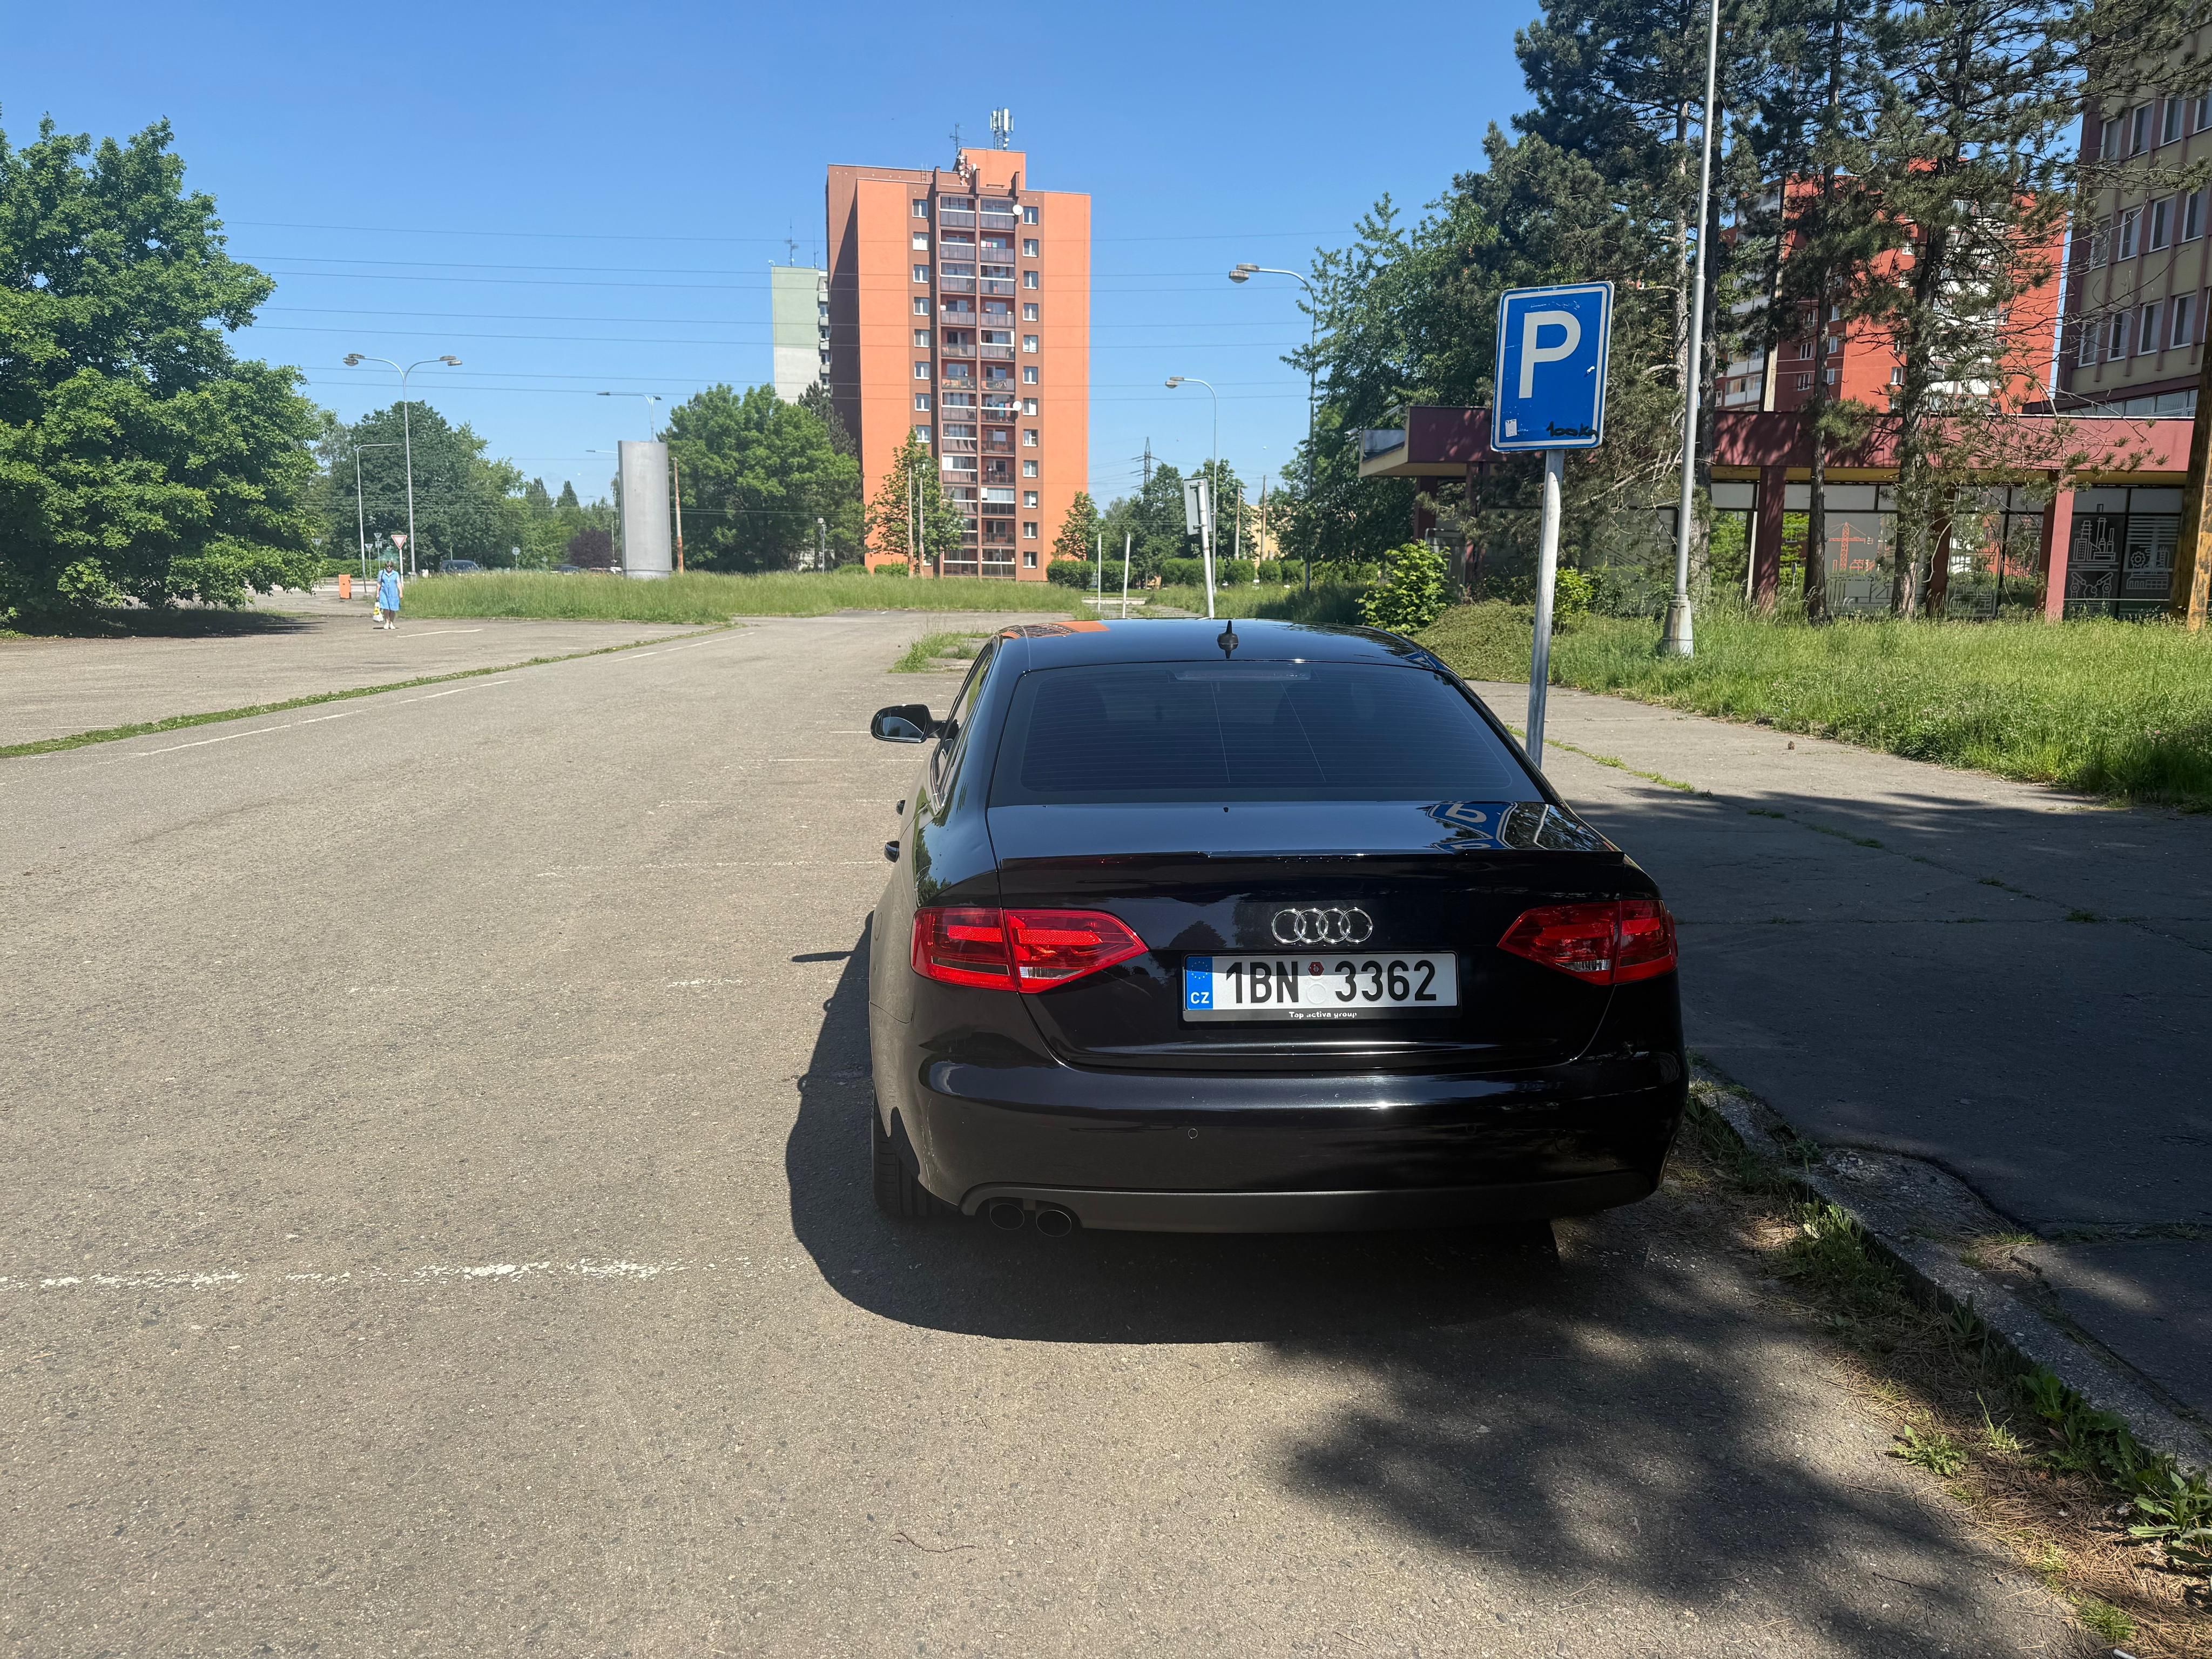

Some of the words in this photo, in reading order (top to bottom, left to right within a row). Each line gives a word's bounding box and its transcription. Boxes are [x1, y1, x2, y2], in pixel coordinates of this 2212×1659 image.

[1519, 310, 1581, 399] P
[1226, 961, 1299, 1003] 1BN
[1334, 960, 1437, 1001] 3362
[1190, 992, 1210, 1004] CZ
[1289, 1011, 1304, 1019] Top
